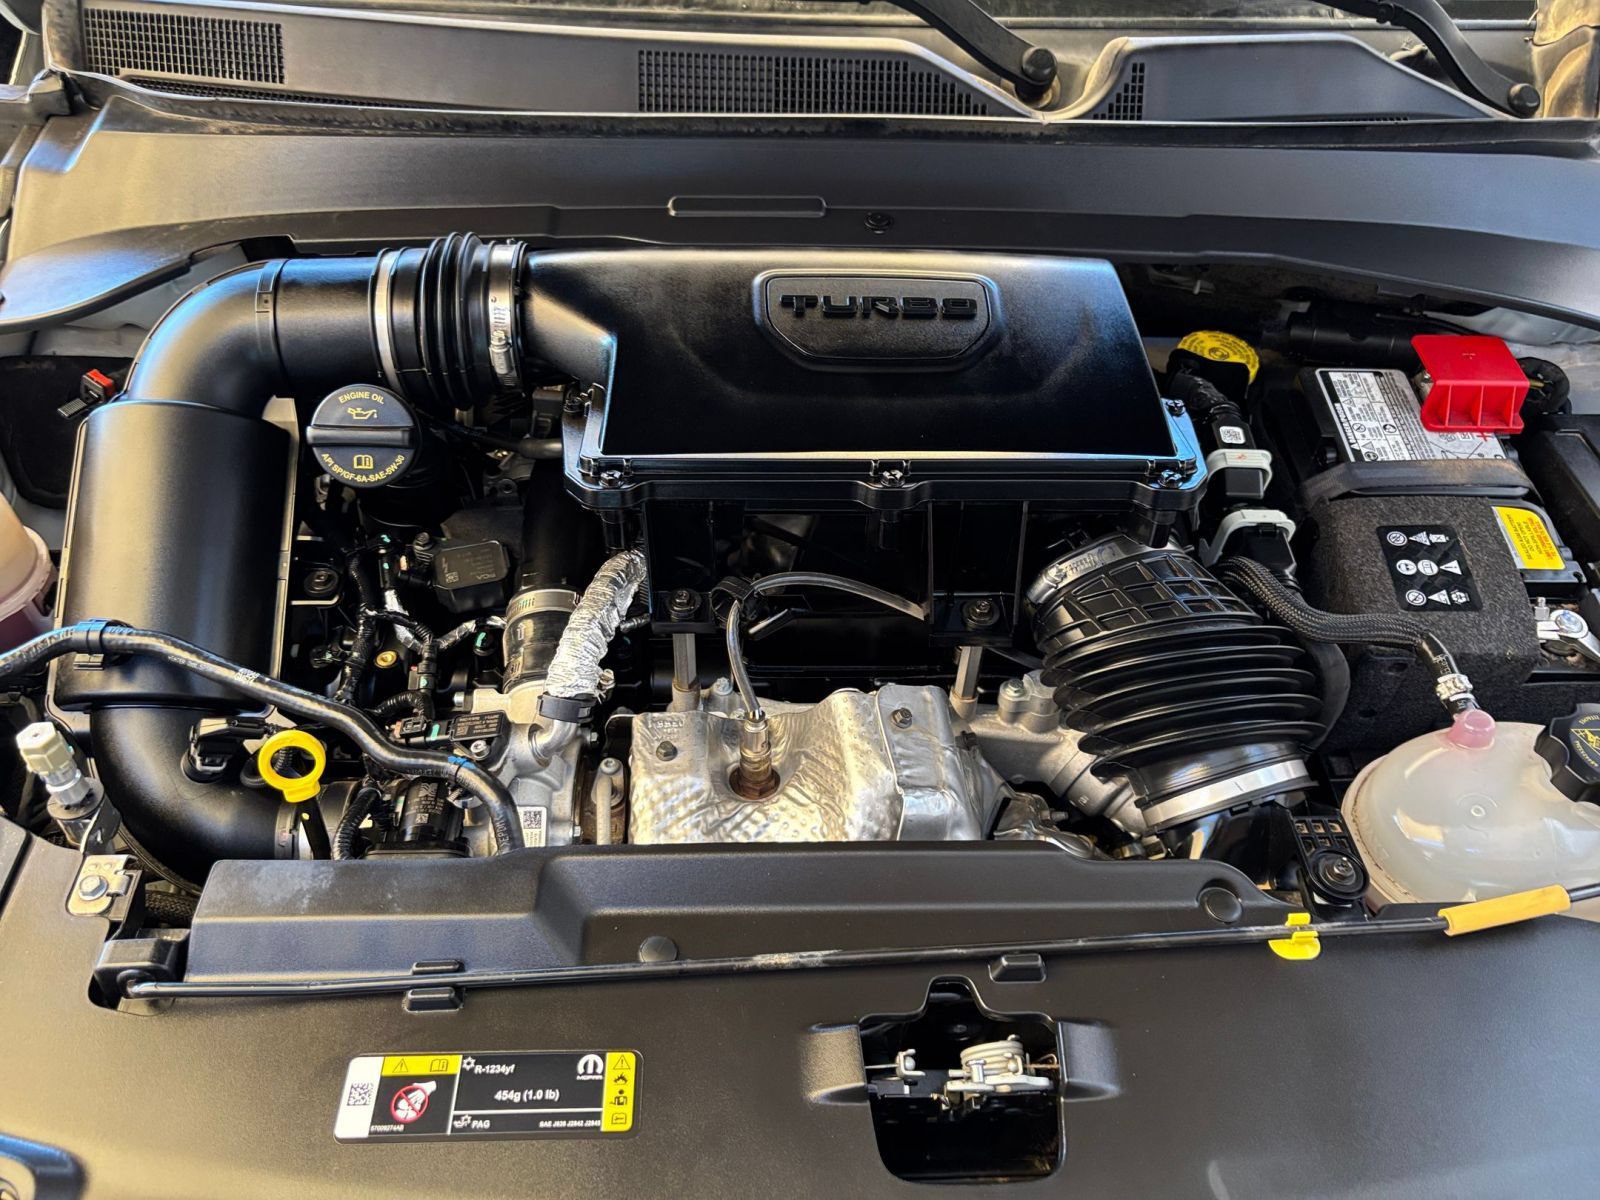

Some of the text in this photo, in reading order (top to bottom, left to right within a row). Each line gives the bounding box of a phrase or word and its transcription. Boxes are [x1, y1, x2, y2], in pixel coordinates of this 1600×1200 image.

[780, 294, 978, 320] TURBO
[338, 391, 384, 405] ENGINE OIL
[321, 453, 334, 467] API
[474, 1063, 515, 1075] R-1234yf
[494, 1089, 560, 1102] 454g (1.0 lb)
[471, 1119, 491, 1129] PAG
